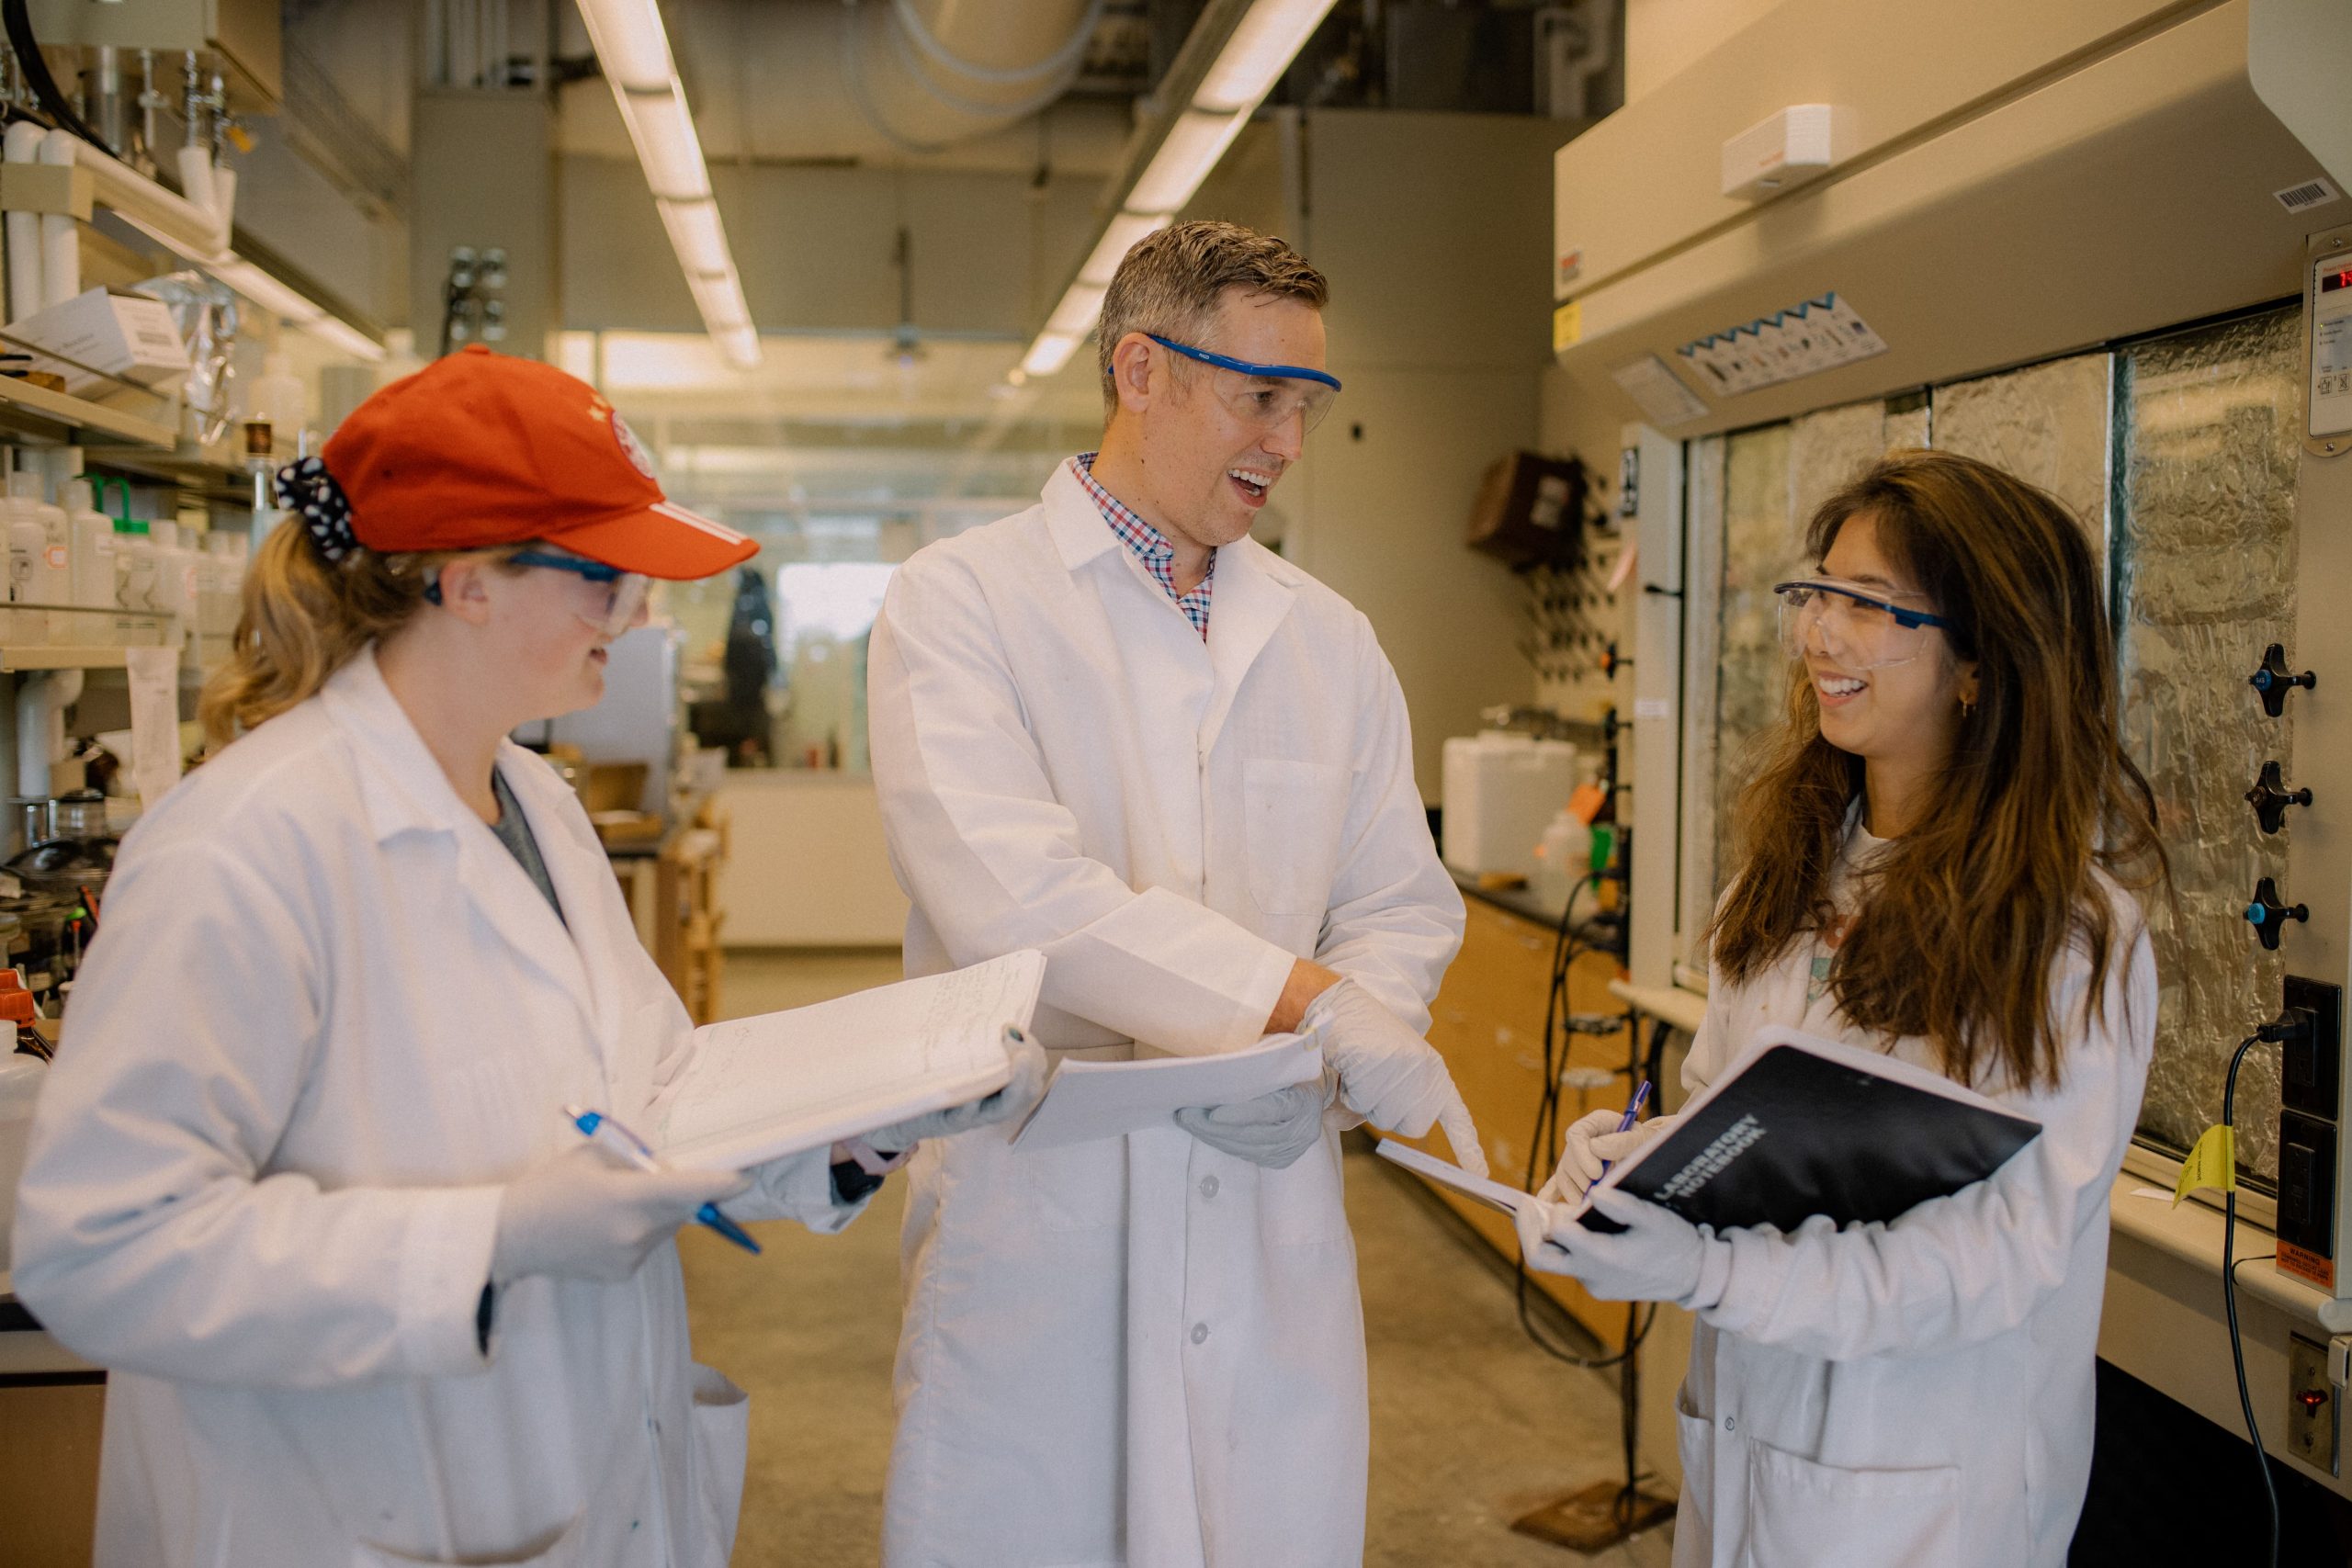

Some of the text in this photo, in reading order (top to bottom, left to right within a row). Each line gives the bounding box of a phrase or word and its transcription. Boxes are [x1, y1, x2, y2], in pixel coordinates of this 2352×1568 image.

[1654, 1112, 1759, 1201] LABORATORY
[1677, 1126, 1767, 1198] NOTEBOOK
[2290, 1248, 2320, 1266] WARNING
